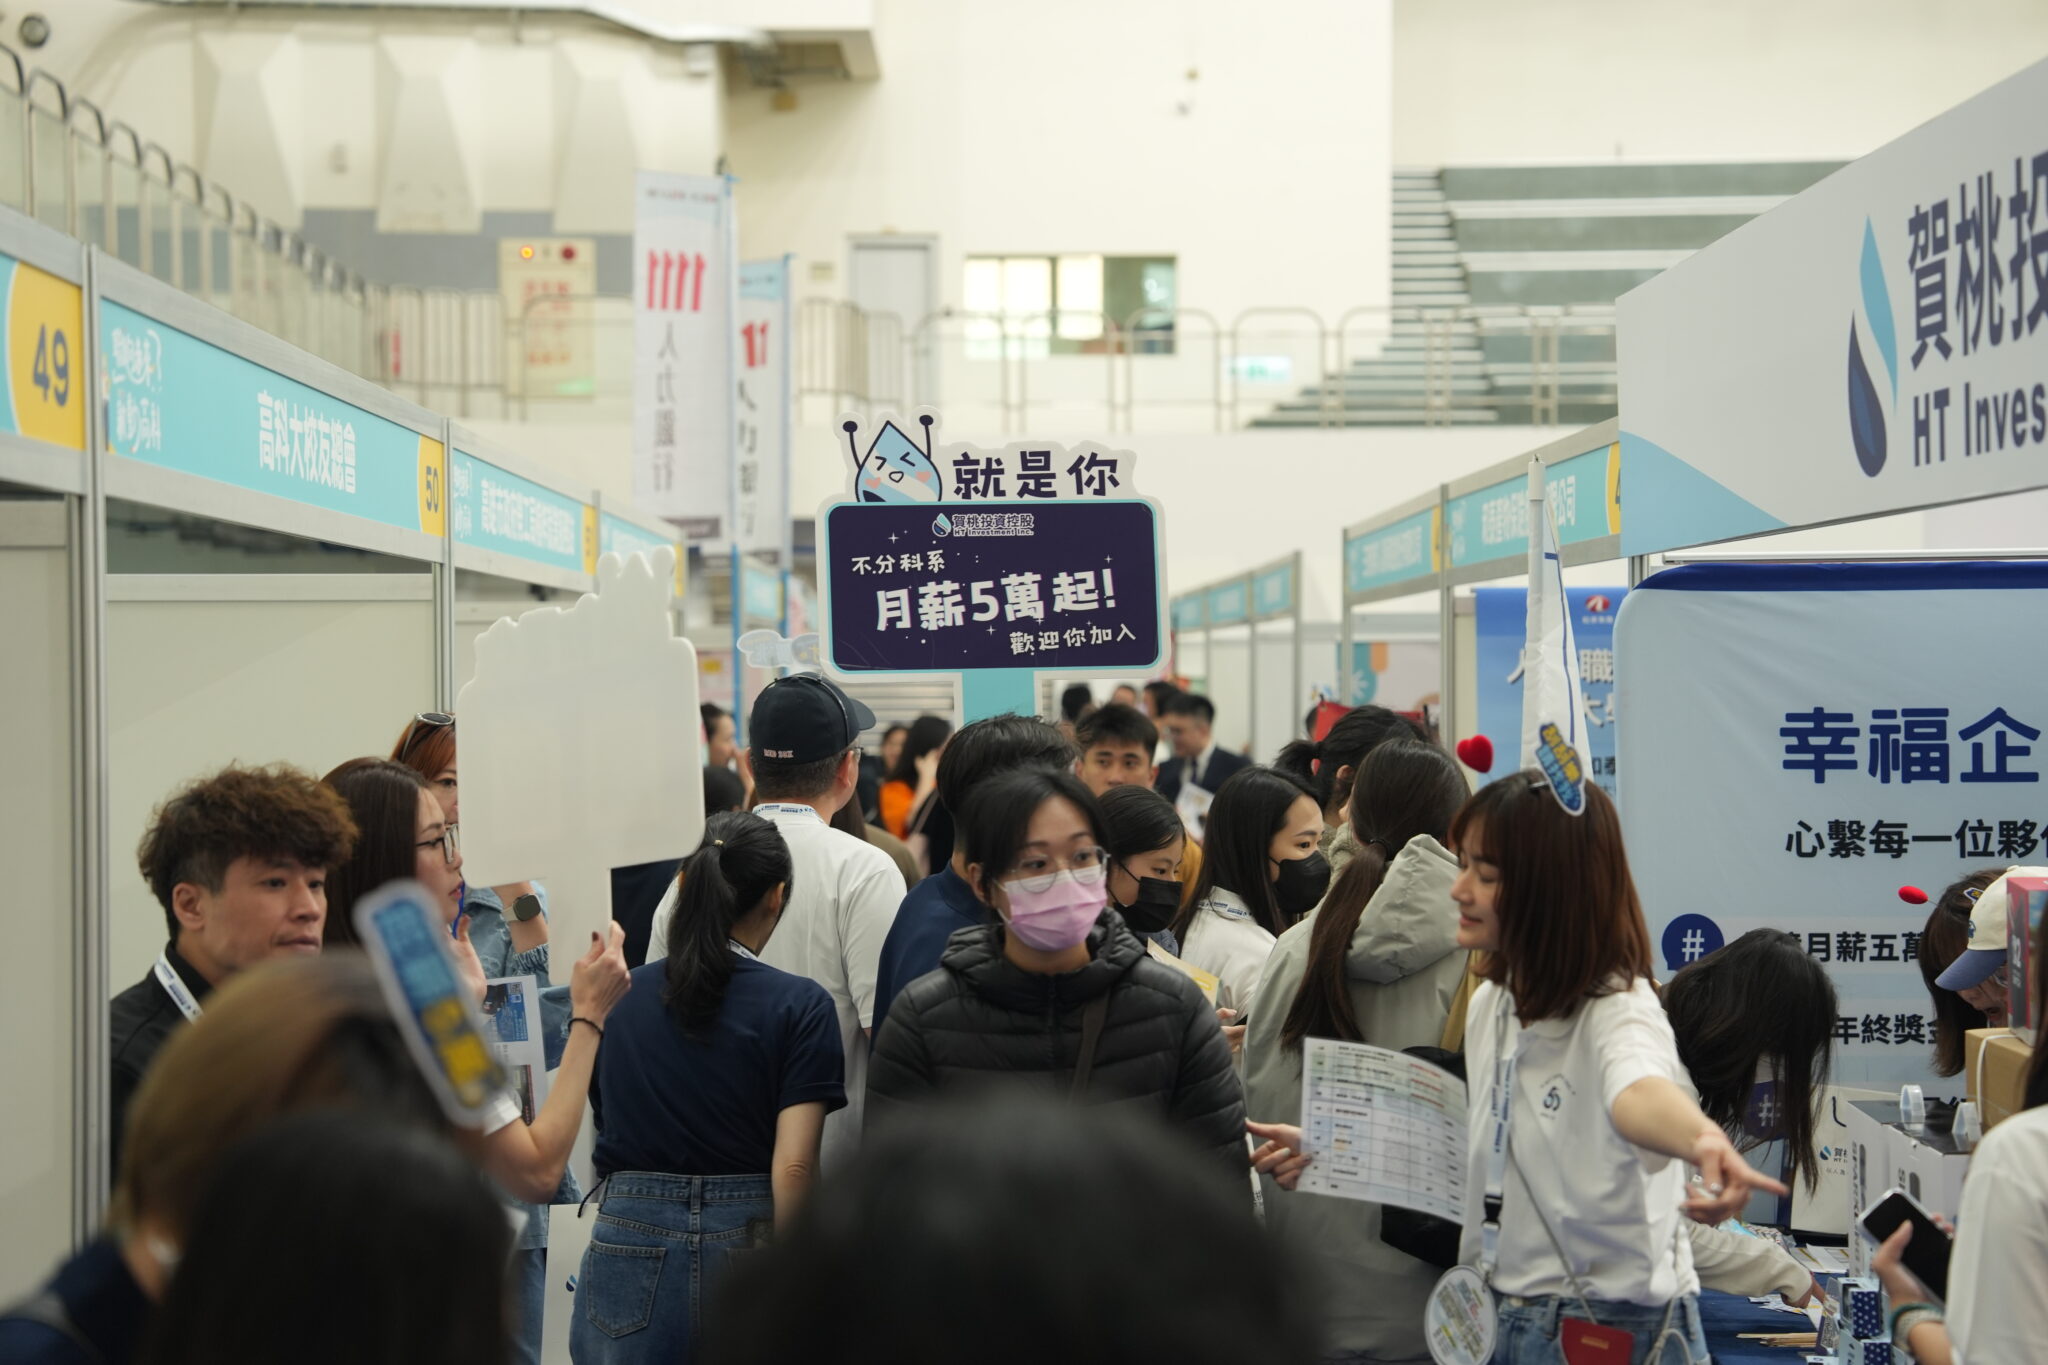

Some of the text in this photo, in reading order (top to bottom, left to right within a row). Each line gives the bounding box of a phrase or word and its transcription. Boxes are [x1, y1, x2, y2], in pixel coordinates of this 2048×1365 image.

[1908, 151, 2048, 370] 賀桃投
[32, 322, 70, 408] 49
[257, 389, 356, 495] 高科大校友總會
[1913, 387, 1950, 467] HT
[426, 465, 440, 513] 50
[952, 450, 1121, 500] 就是你
[952, 513, 1035, 529] 賀桃投資控股
[953, 527, 1035, 537] HT Investment Inc.
[852, 550, 946, 575] 不分科系
[876, 567, 1117, 632] 月薪5萬起!
[1009, 623, 1138, 656] 歡迎你加入
[1779, 706, 2041, 784] 幸福企
[1787, 931, 1924, 963] 月薪五萬
